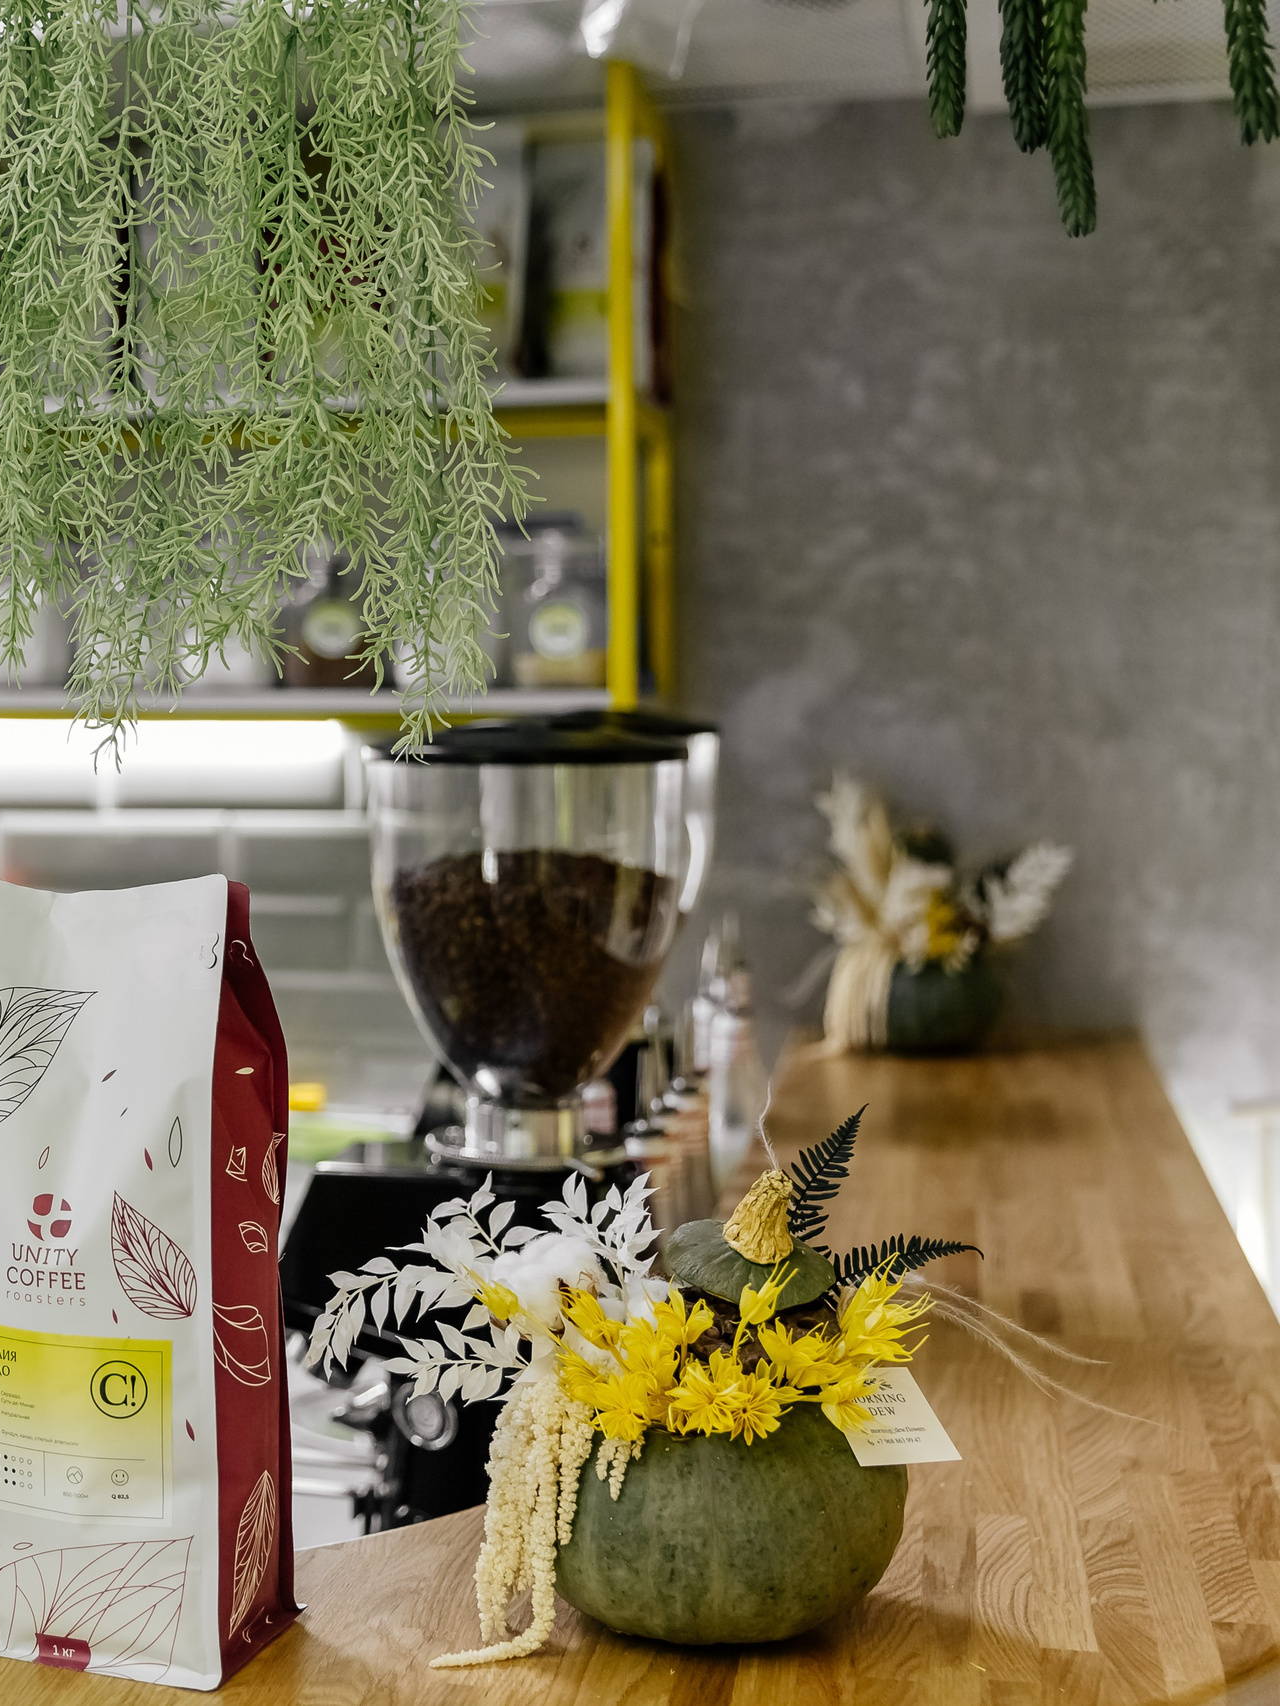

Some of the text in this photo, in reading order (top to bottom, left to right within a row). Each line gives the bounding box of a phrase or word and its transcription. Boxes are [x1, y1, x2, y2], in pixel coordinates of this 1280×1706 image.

[11, 1242, 78, 1267] UNITY
[6, 1266, 86, 1291] COFFEE
[6, 1290, 86, 1307] roasters
[867, 1406, 896, 1417] DEW
[52, 1644, 76, 1658] 1 кг
